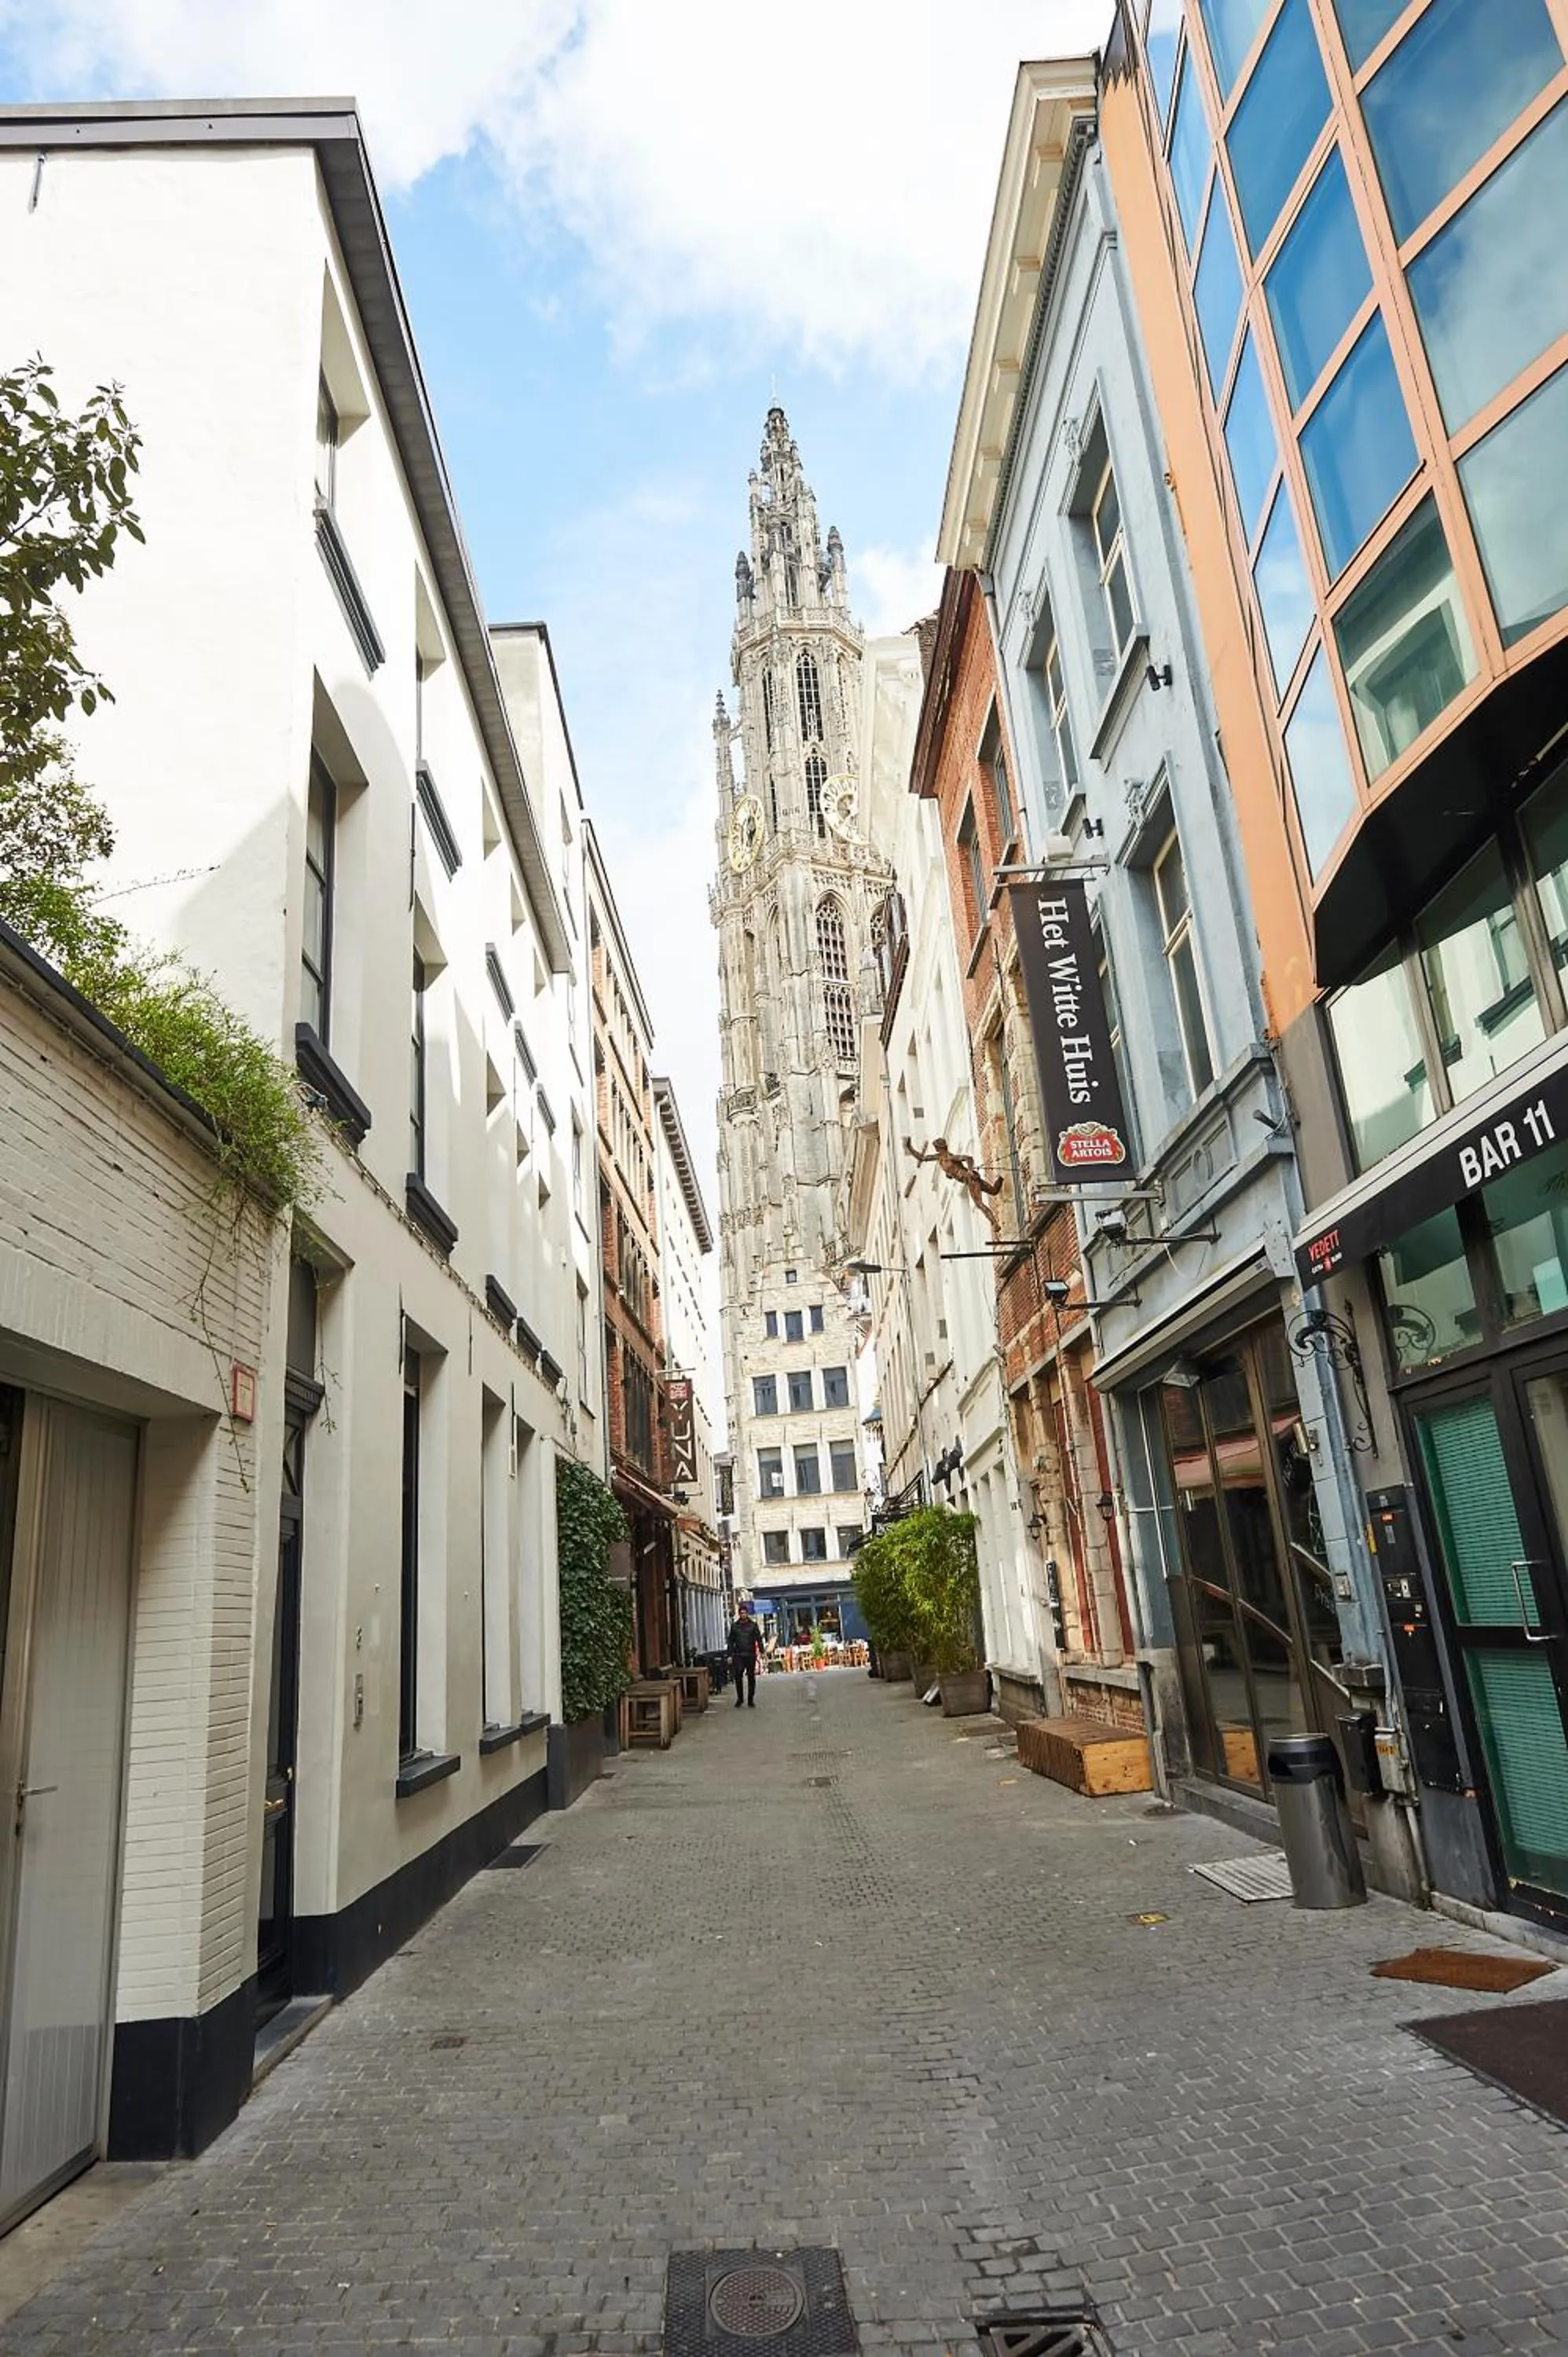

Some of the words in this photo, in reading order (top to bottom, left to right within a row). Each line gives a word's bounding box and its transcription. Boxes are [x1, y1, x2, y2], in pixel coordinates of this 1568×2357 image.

[1038, 896, 1071, 949] Het
[1047, 953, 1083, 1028] Witte
[1060, 1033, 1098, 1104] Huis
[1070, 1138, 1111, 1149] STELLA
[1071, 1148, 1112, 1158] ARTOIS
[1459, 1121, 1522, 1189] BAR
[1523, 1099, 1555, 1147] 11
